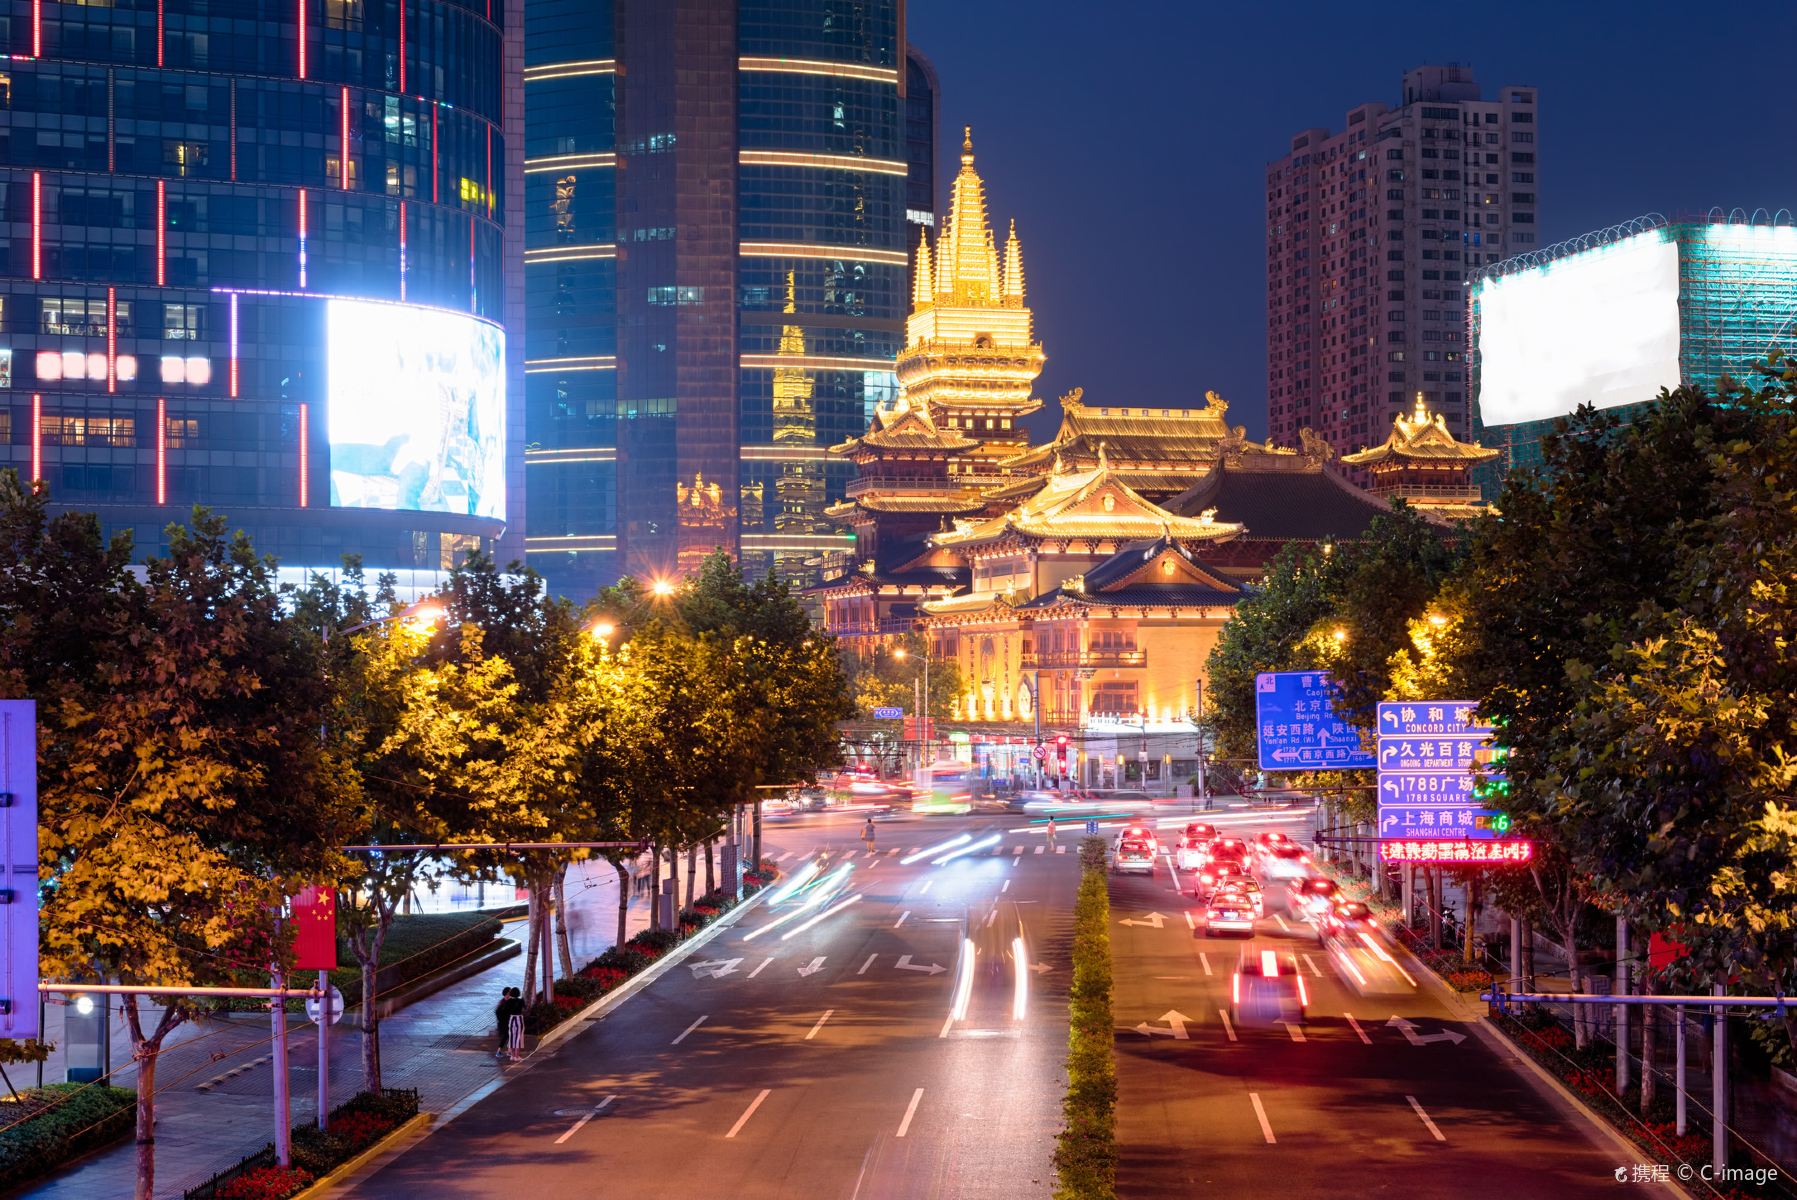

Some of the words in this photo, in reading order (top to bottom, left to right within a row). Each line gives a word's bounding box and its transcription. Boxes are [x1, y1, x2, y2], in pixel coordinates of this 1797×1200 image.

[1265, 676, 1274, 685] 北
[1294, 700, 1344, 712] 北京西
[1296, 712, 1320, 722] Beijing
[1400, 706, 1470, 723] 协和城
[1263, 723, 1315, 737] 延安西路
[1405, 723, 1444, 733] CONCORD
[1447, 723, 1467, 733] CITY
[1303, 735, 1315, 744] (W)
[1302, 749, 1346, 759] 南京西路
[1400, 741, 1473, 757] 久光百货
[1424, 758, 1454, 768] DEPARTMENT
[1400, 776, 1474, 792] 1788广场
[1406, 793, 1428, 802] 1788
[1430, 793, 1467, 802] SQUARE
[1401, 810, 1473, 826] 上海商城
[1406, 827, 1440, 837] SHANGHAI
[1441, 827, 1467, 837] CENTRE
